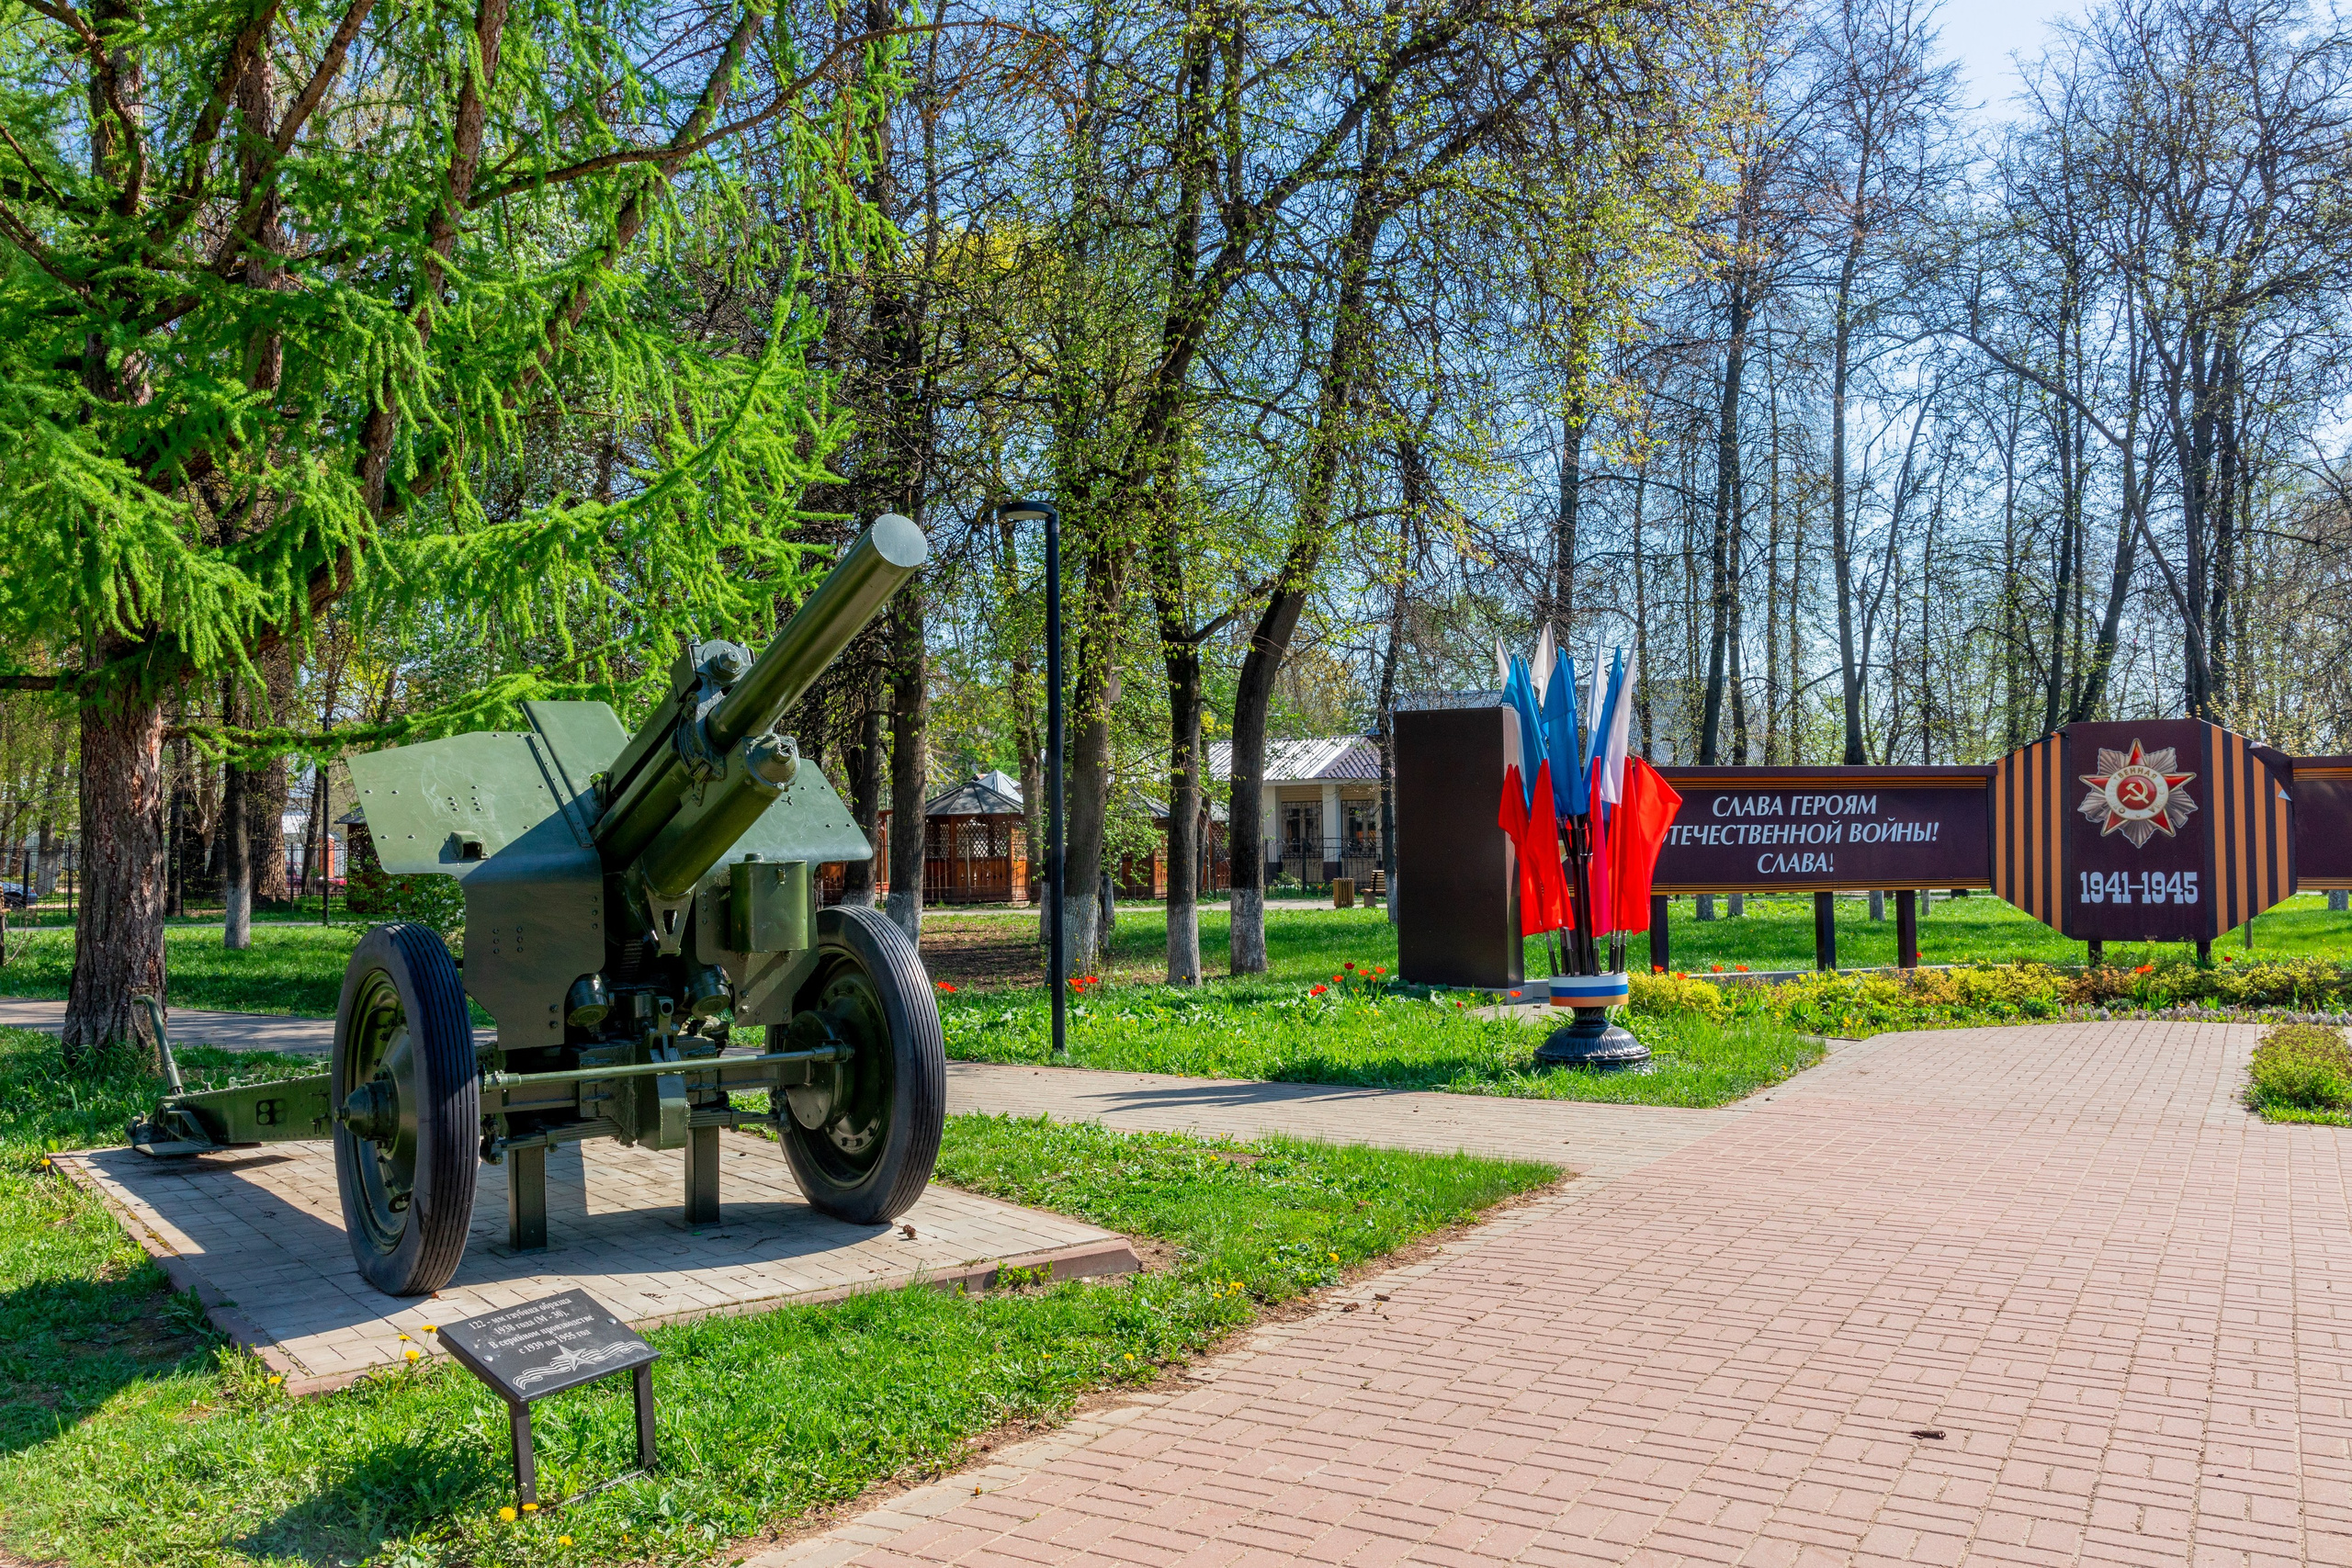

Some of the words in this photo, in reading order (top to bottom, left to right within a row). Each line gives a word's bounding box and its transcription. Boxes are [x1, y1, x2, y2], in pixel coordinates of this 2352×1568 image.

[1712, 795, 1783, 817] СЛАВА
[1790, 795, 1877, 816] ГЕРОЯМ
[1662, 819, 1842, 846] ТЕЧЕСТВЕННОЙ
[1848, 817, 1939, 843] ВОЙНЫ!
[1757, 852, 1835, 874] СЛАВА!
[469, 1320, 486, 1330] 122
[491, 1315, 506, 1325] мм
[505, 1306, 540, 1320] гаубица
[538, 1298, 572, 1311] образца
[487, 1341, 499, 1349] В
[498, 1330, 541, 1347] серийном
[539, 1314, 595, 1336] производстве
[493, 1324, 516, 1335] 1938
[514, 1319, 536, 1329] года
[523, 1340, 545, 1353] 1939
[544, 1338, 558, 1347] по
[554, 1332, 577, 1343] 1955
[575, 1328, 593, 1337] год
